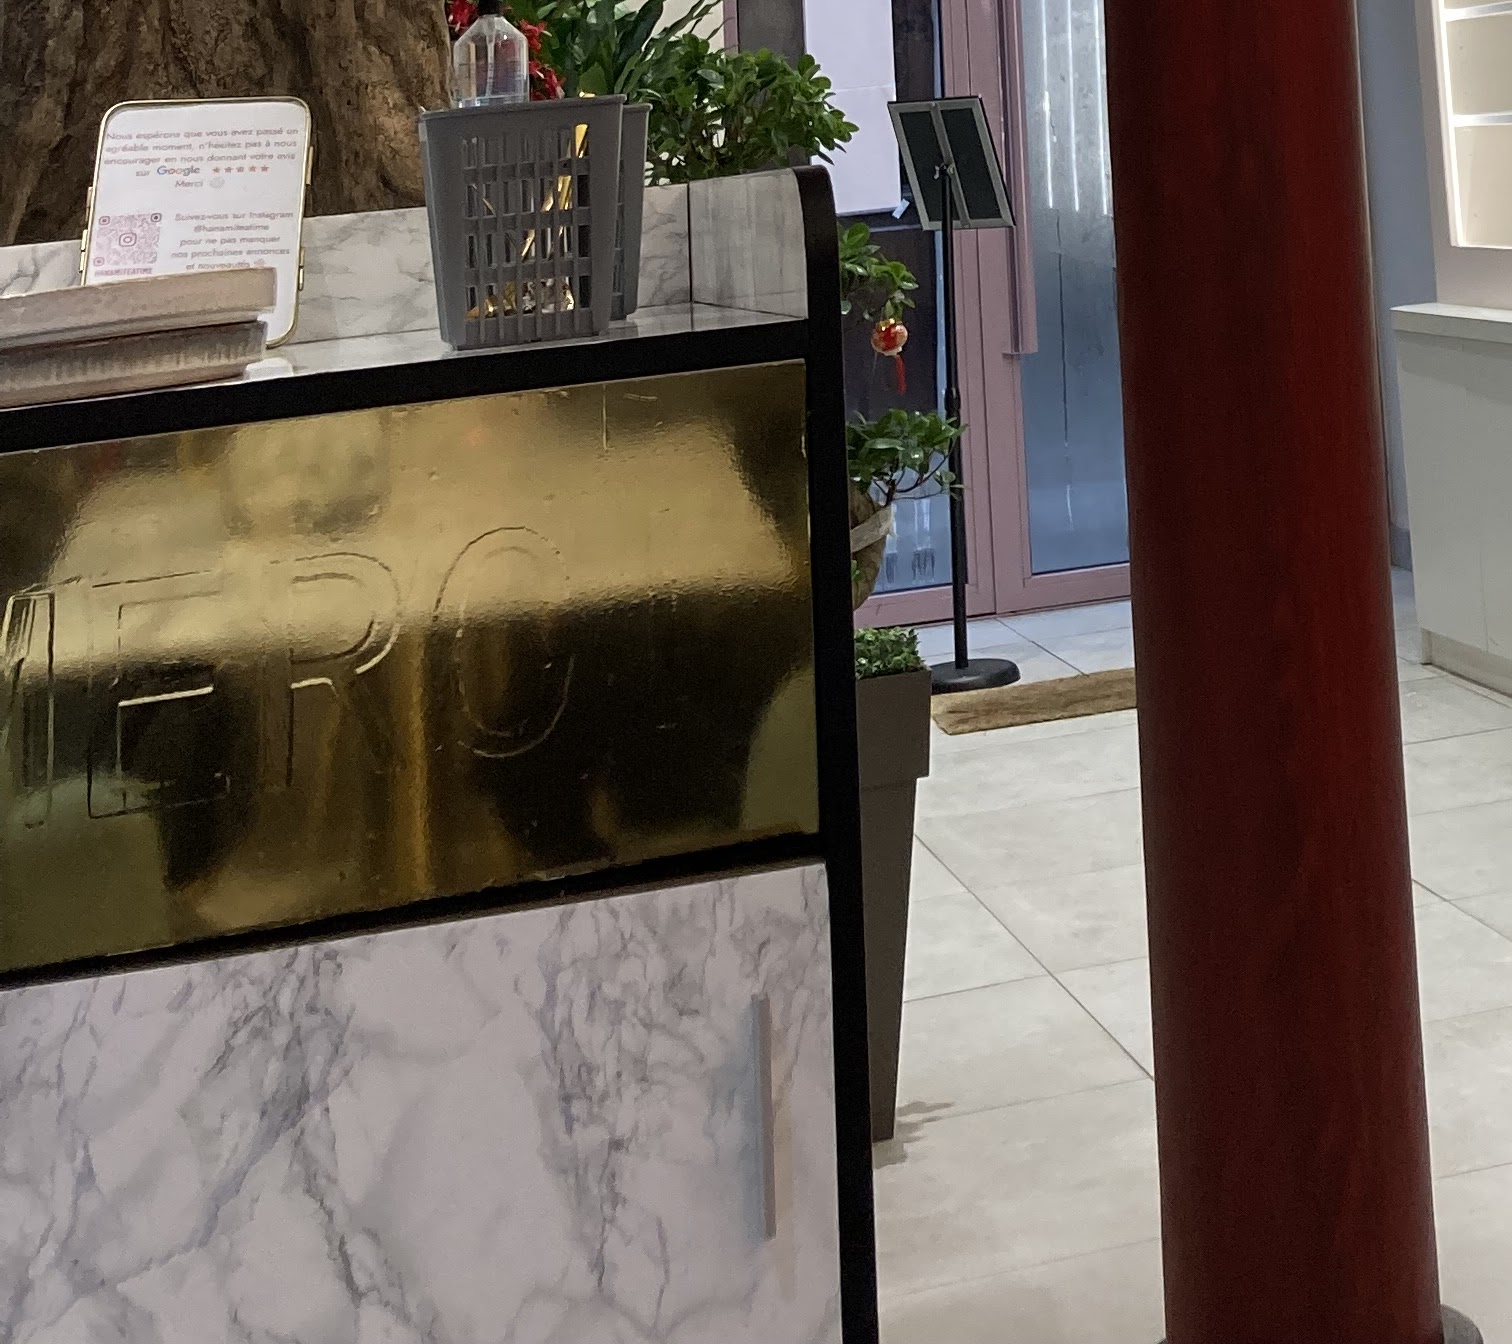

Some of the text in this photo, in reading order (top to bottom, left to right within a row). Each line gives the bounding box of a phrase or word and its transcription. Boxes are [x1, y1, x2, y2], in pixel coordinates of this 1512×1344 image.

[256, 127, 283, 136] passé
[207, 153, 247, 162] donnant
[156, 165, 201, 177] Google
[174, 179, 204, 188] Merci
